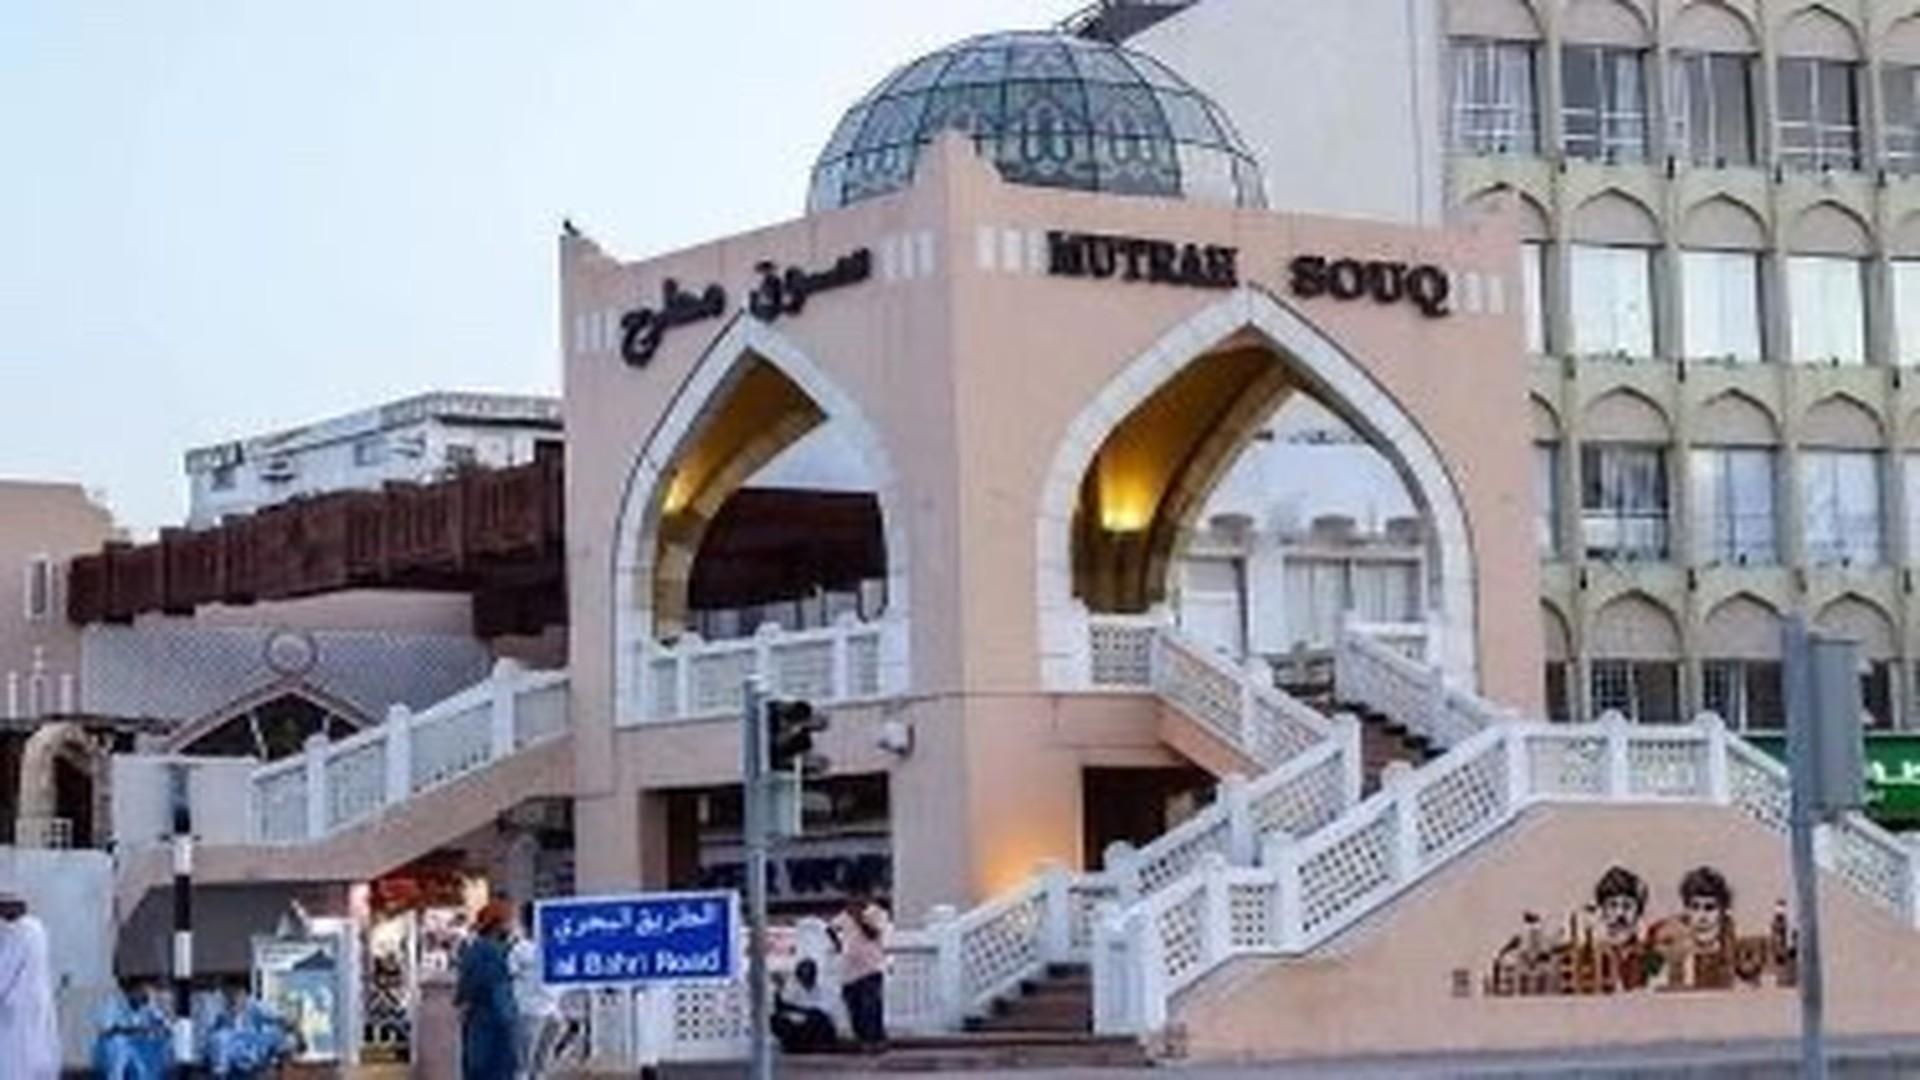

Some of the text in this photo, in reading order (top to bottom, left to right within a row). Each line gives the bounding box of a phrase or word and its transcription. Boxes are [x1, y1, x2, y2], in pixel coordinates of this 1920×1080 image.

[620, 246, 870, 369] سوق مطرح
[1046, 230, 1450, 318] MUTRAH SOUQ
[583, 949, 649, 976] Bahri
[655, 947, 720, 973] Road
